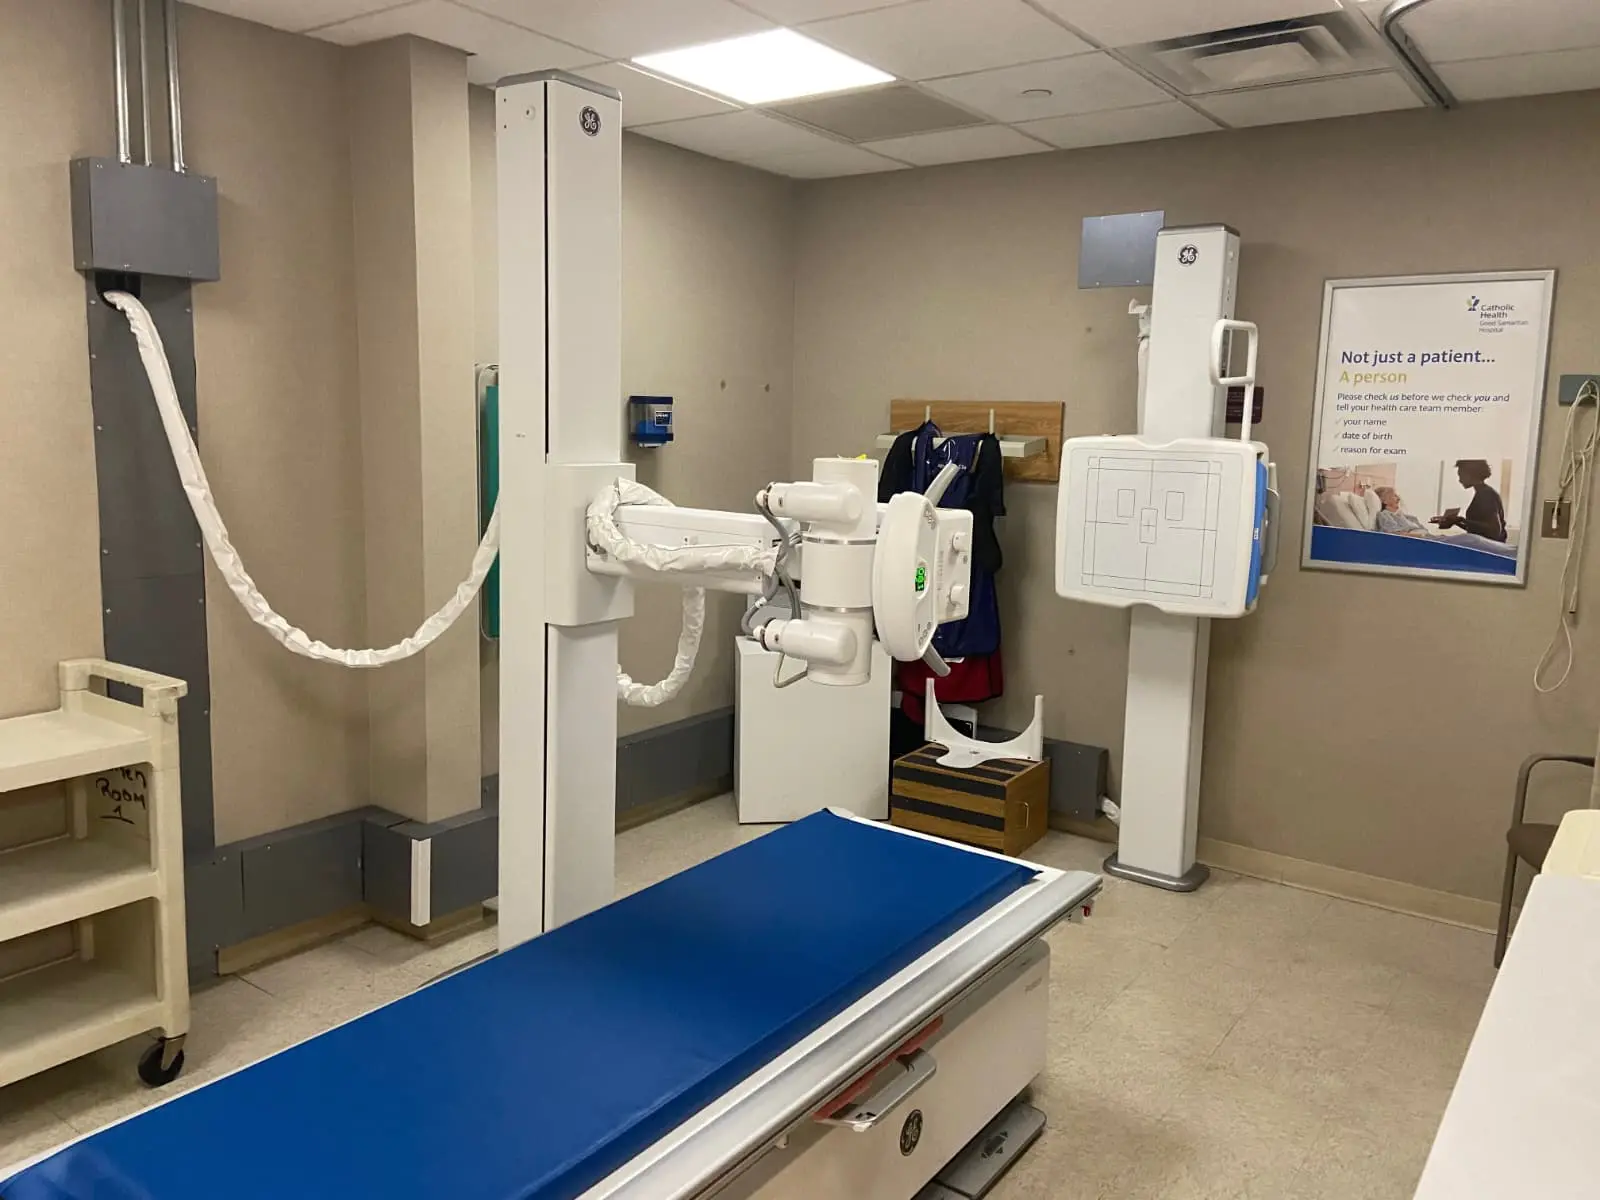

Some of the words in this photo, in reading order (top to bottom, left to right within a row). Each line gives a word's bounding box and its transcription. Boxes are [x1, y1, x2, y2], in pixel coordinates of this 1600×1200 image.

[1480, 311, 1508, 319] Health
[1341, 351, 1370, 364] Not
[1371, 350, 1403, 367] just
[1407, 353, 1416, 363] a
[1420, 349, 1495, 366] patient...
[1339, 370, 1350, 382] A
[1353, 372, 1407, 387] person
[1337, 393, 1363, 401] Please
[1364, 392, 1388, 401] check
[1401, 393, 1429, 401] before
[1446, 394, 1471, 402] check
[1473, 395, 1491, 403] you
[1492, 394, 1510, 402] and
[1336, 403, 1349, 411] tell
[1350, 404, 1369, 413] your
[1370, 404, 1397, 412] health
[1343, 419, 1361, 427] your
[1342, 431, 1360, 440] date
[1361, 432, 1371, 440] of
[1369, 446, 1382, 454] for
